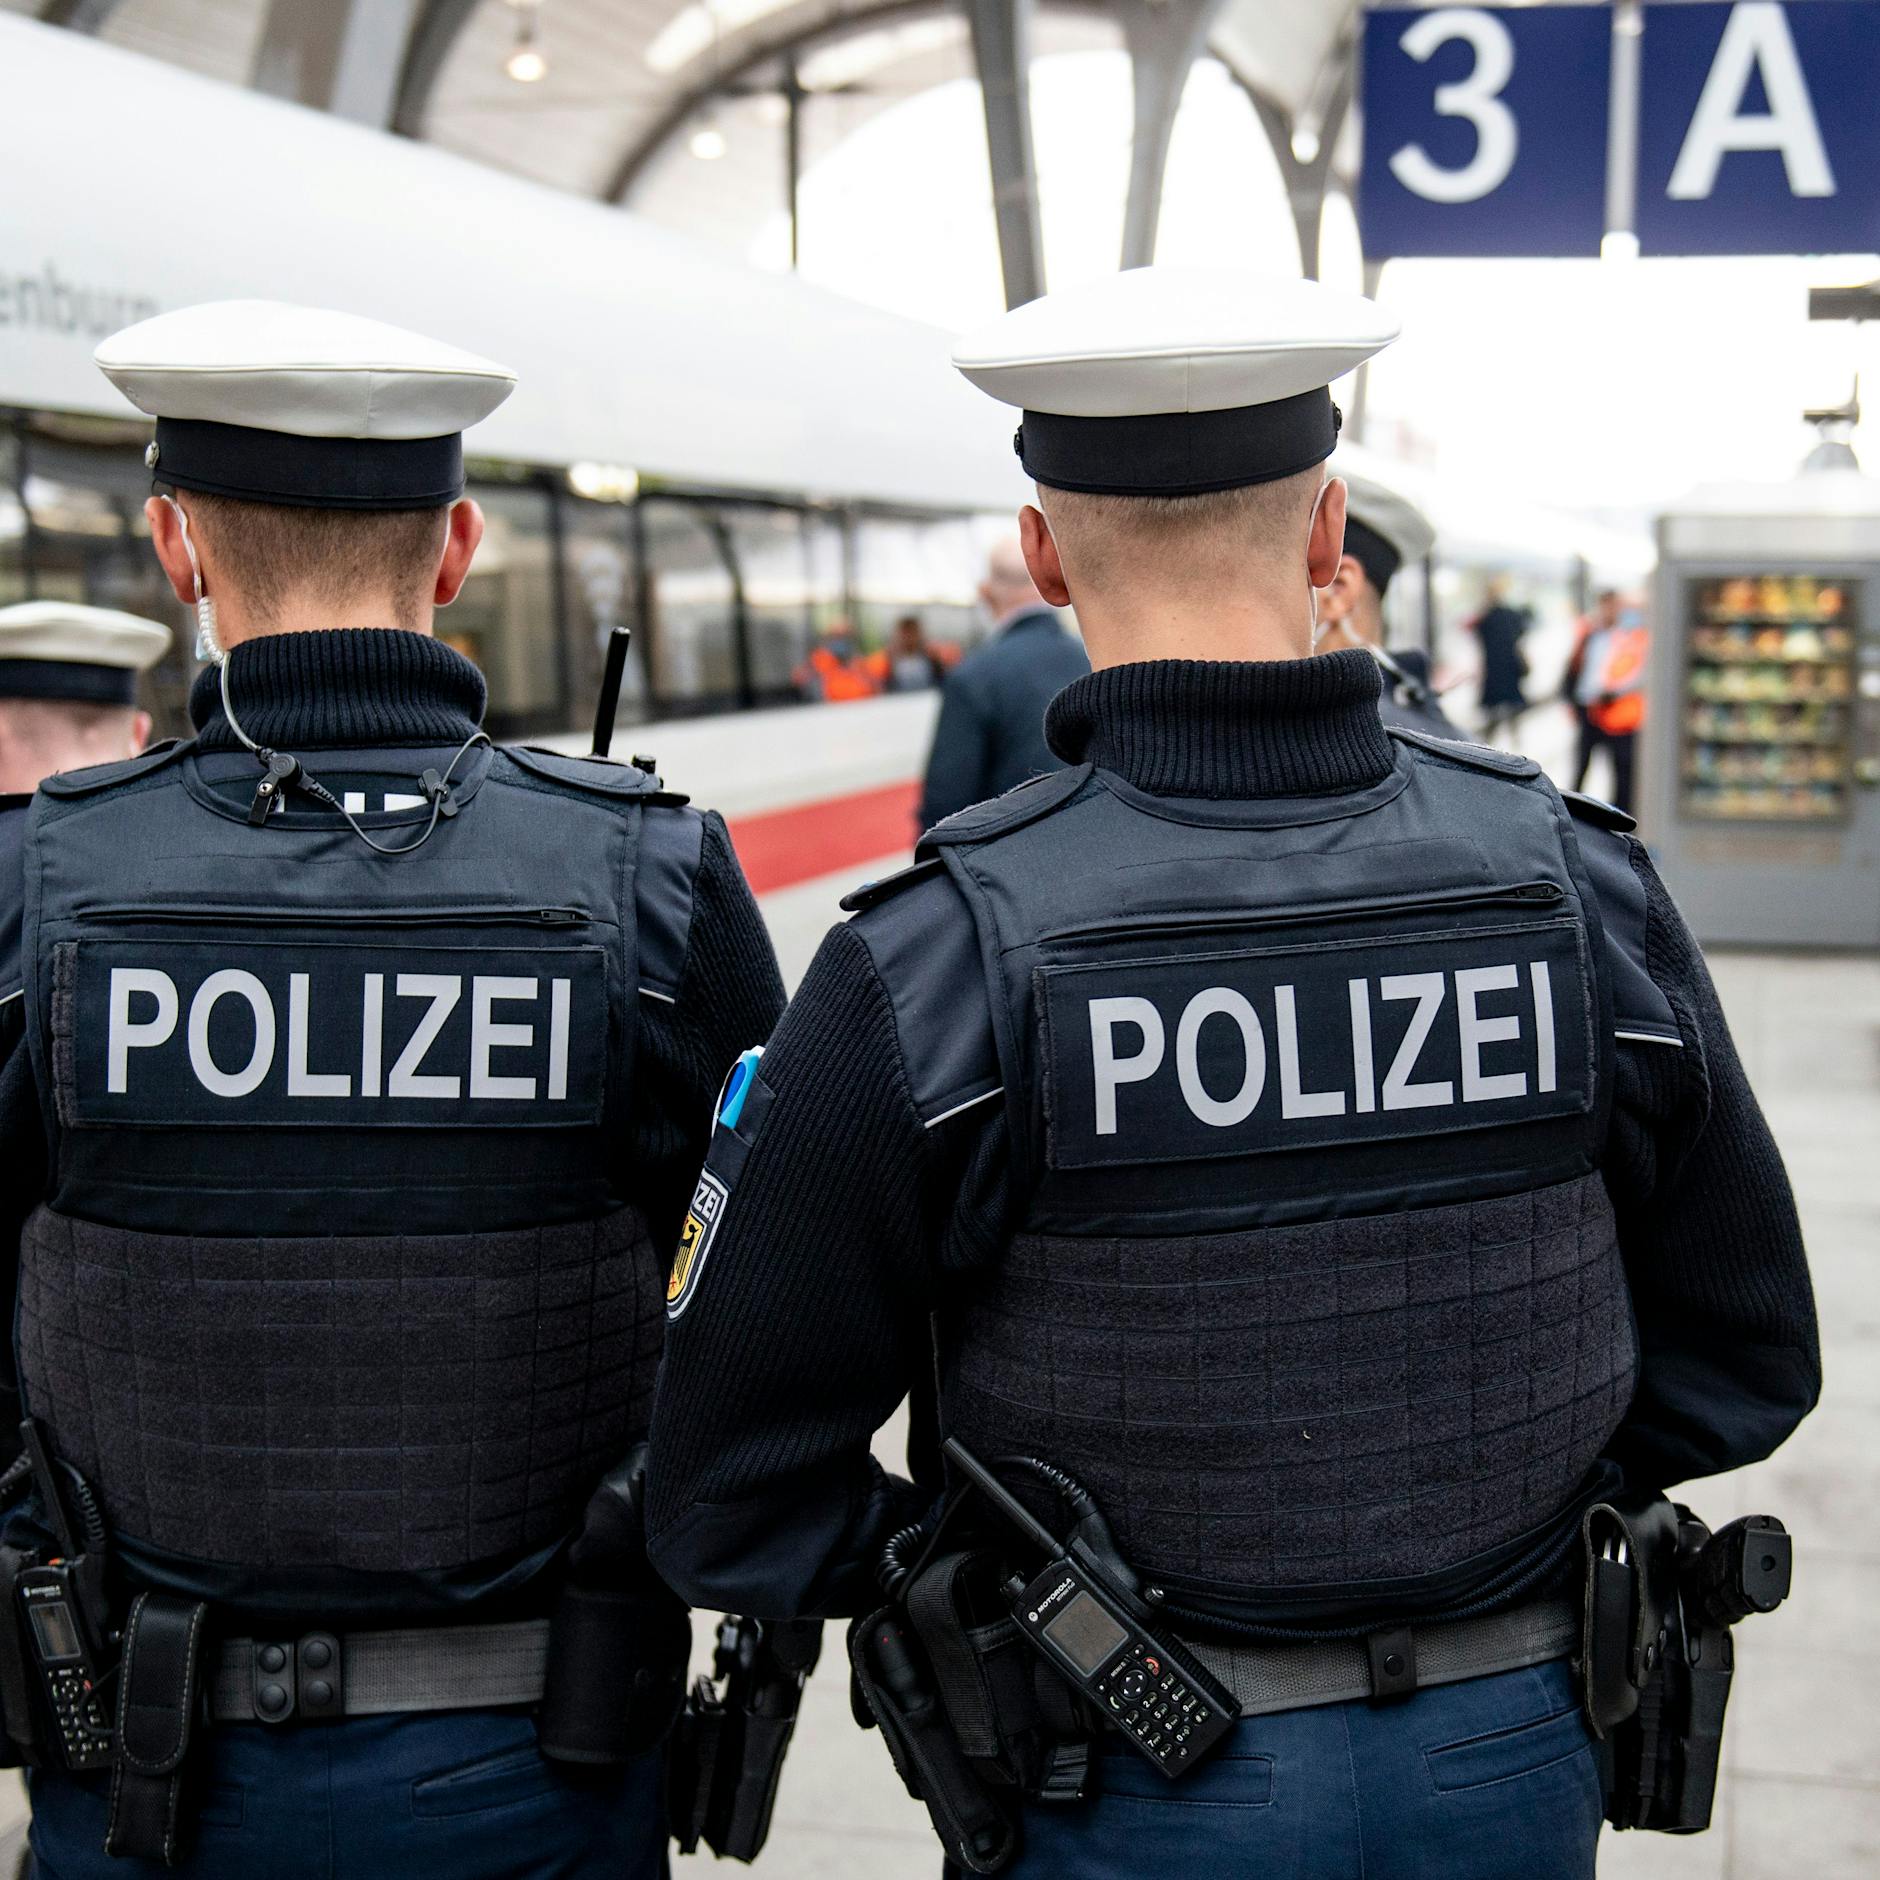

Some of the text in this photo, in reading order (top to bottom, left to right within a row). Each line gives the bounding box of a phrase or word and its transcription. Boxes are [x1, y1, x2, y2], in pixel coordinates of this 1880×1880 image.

[1389, 9, 1518, 203] 3
[1666, 1, 1836, 198] A
[108, 968, 571, 1100] POLIZEI
[1089, 961, 1556, 1135] POLIZEI
[1038, 1578, 1072, 1613] MOTOROLA
[1154, 1711, 1161, 1719] 5
[1161, 1682, 1169, 1690] 3
[1137, 1728, 1143, 1736] 4
